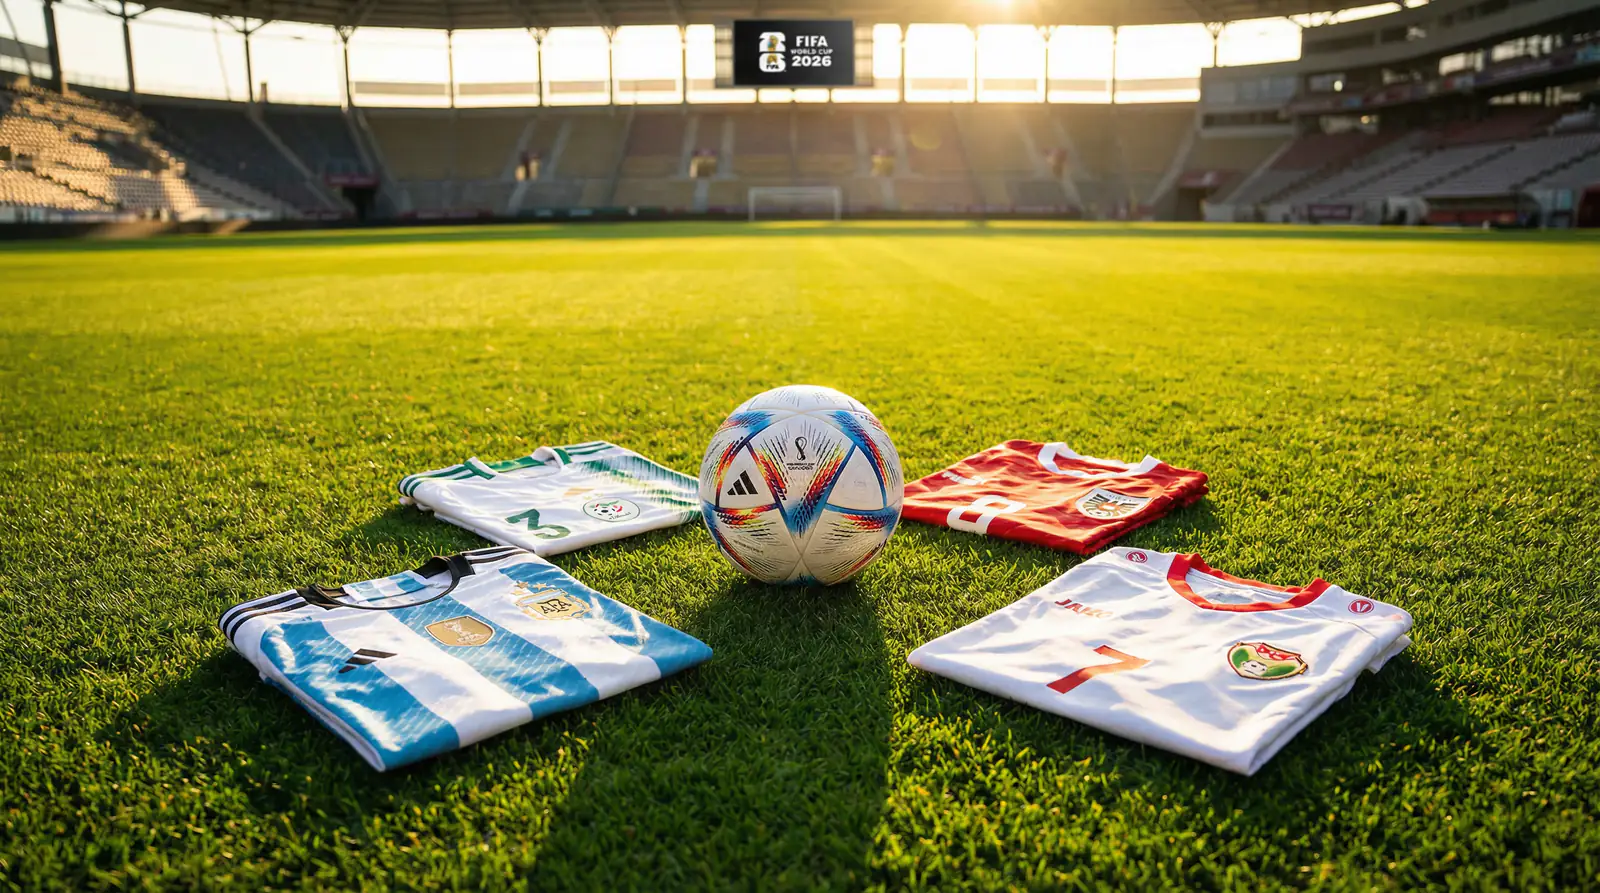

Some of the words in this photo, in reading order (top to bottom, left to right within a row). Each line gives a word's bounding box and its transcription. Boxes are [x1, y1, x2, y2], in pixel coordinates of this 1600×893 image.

[796, 35, 828, 47] FIFA
[791, 55, 832, 67] 2026
[506, 508, 571, 539] 3
[947, 495, 1026, 535] 8
[1046, 645, 1150, 694] 7
